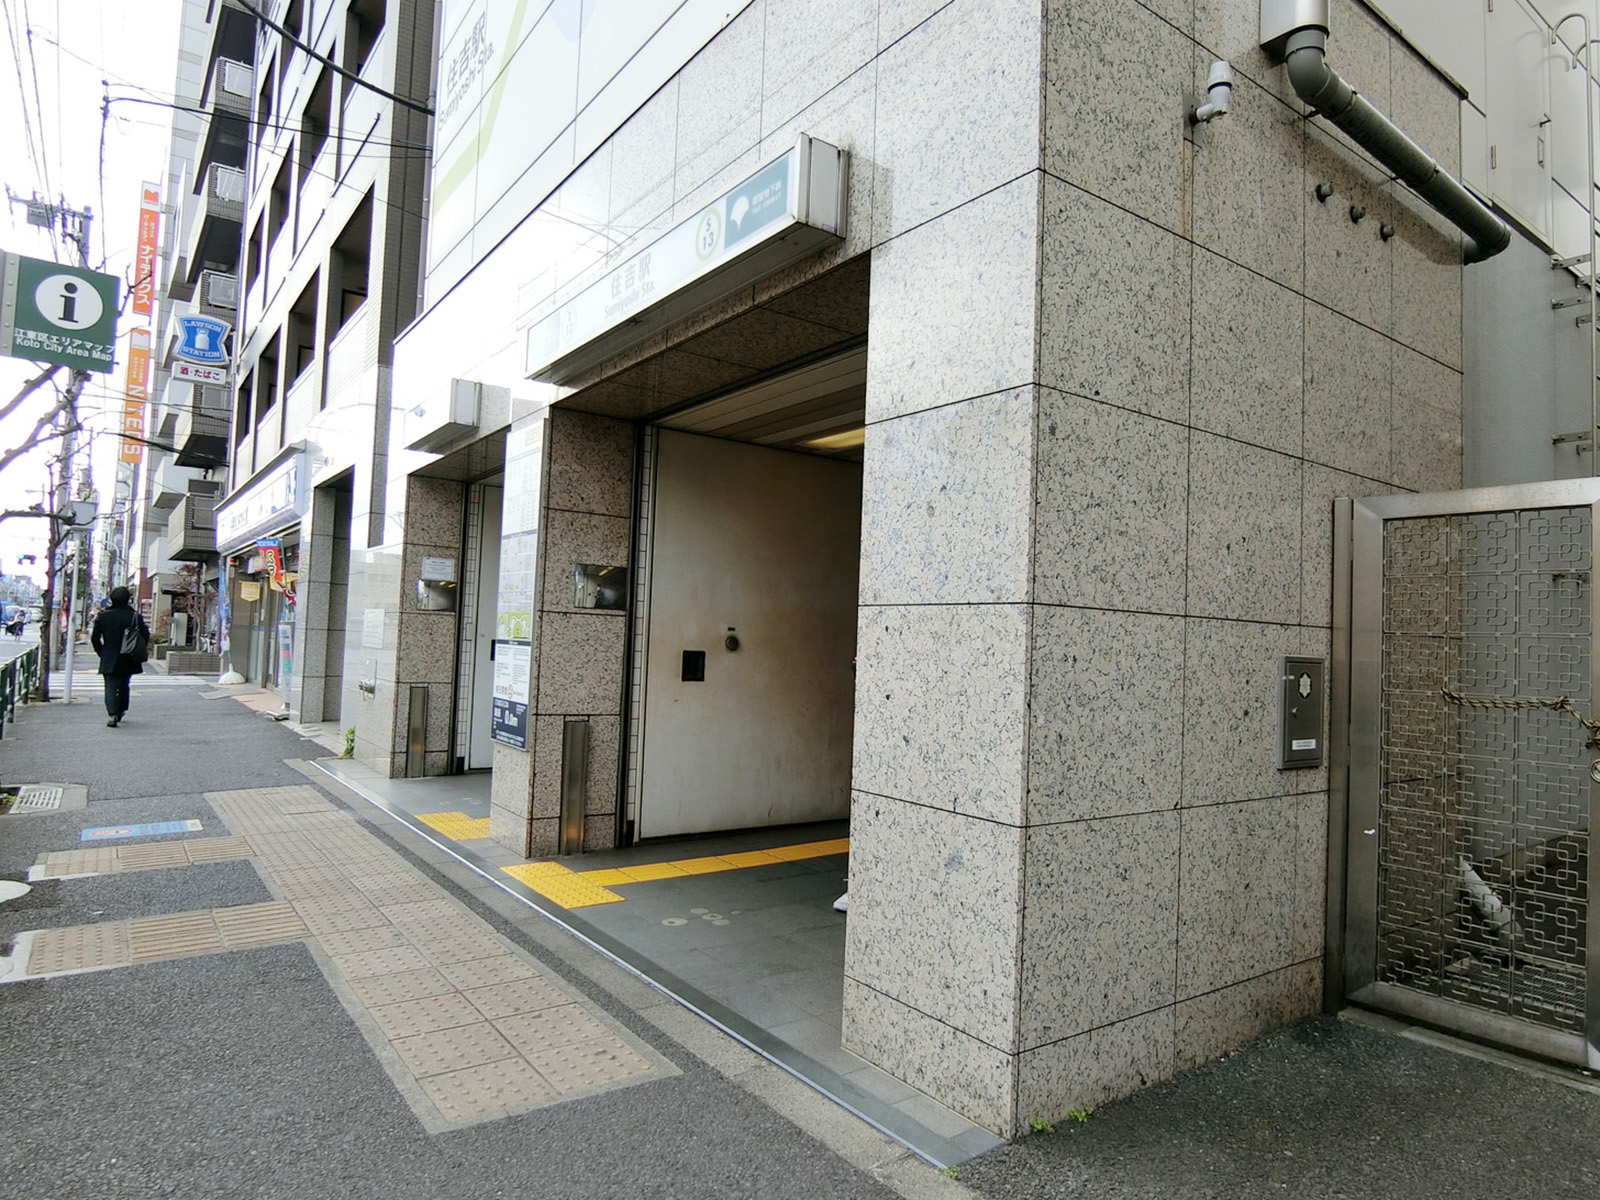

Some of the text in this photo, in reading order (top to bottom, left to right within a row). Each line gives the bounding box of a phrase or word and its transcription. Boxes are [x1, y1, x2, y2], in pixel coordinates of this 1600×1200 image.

[446, 10, 486, 98] 住吉駅
[438, 42, 495, 132] Sumiyoshi Sta.
[705, 217, 712, 232] S
[703, 231, 714, 250] 13
[611, 252, 652, 299] 住吉駅
[604, 281, 656, 319] Sumiyoshi Sta.
[184, 320, 222, 333] LAWSON
[16, 336, 113, 362] Koto City Area Map
[182, 346, 221, 358] STATION
